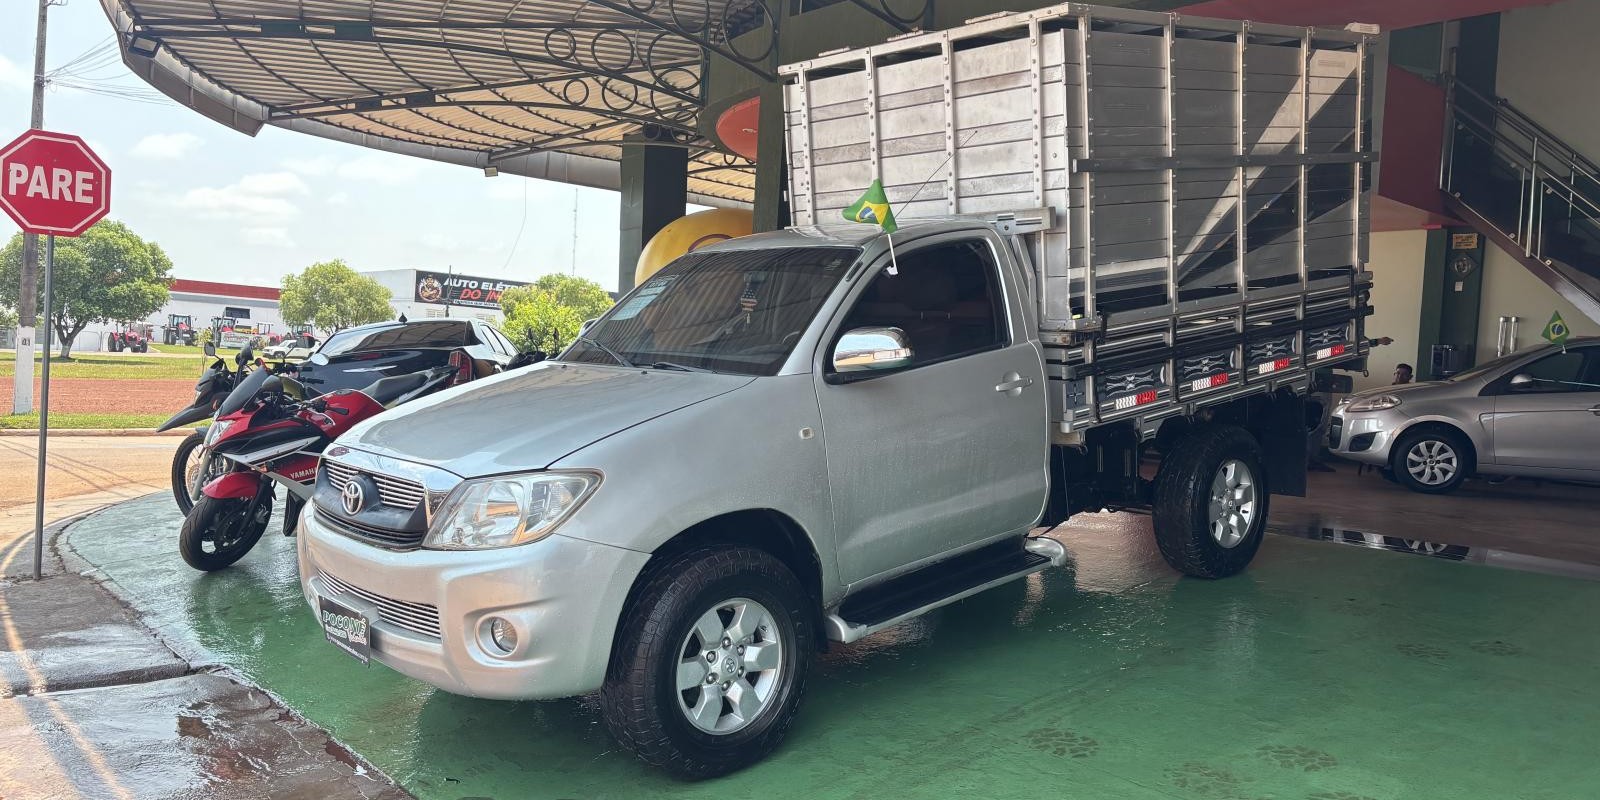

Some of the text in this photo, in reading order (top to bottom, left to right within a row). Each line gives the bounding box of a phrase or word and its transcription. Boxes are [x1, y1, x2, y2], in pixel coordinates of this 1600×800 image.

[8, 162, 94, 204] PARE
[443, 278, 478, 289] AUTO
[460, 288, 481, 300] DO
